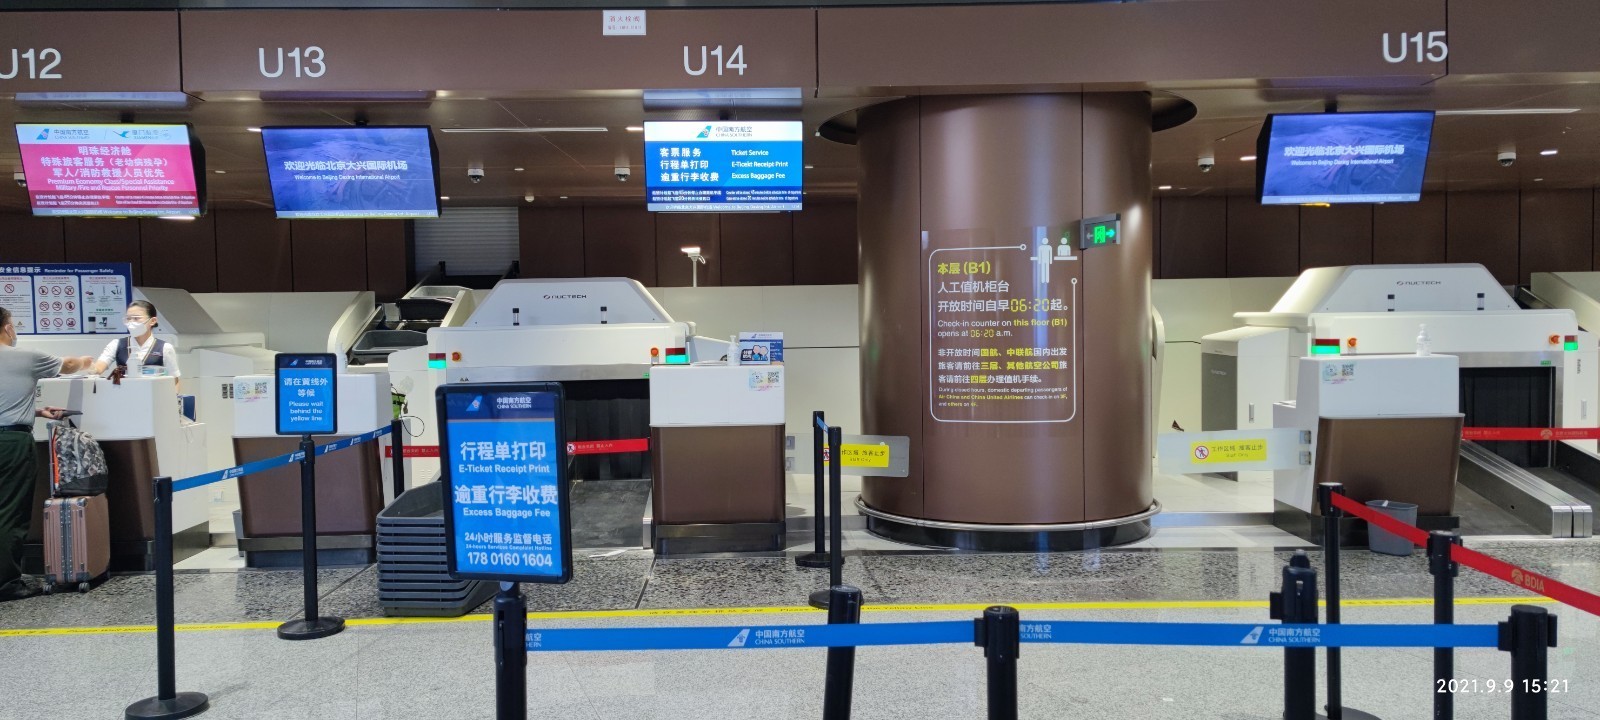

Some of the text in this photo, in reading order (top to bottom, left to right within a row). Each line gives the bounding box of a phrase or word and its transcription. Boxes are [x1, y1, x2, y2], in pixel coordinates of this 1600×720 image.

[1382, 31, 1448, 63] U15
[0, 48, 63, 79] U12
[258, 46, 327, 78] U13
[683, 45, 747, 76] U14
[77, 145, 132, 156] 明珠经济舱
[660, 147, 701, 157] 客票服务
[1284, 144, 1404, 156] 欢迎光临北京大兴国际机场
[284, 160, 408, 171] 欢迎光临北京大兴国际机场
[660, 159, 709, 170] 行程单打印
[753, 161, 774, 169] Receipt
[52, 167, 165, 178] 军人/消防救援人员优先
[660, 172, 719, 182] 逾重行李收费
[750, 172, 775, 180] Baggage
[75, 178, 103, 186] Economy
[937, 280, 1009, 293] 人工值机柜台
[937, 319, 970, 327] Check-in
[1013, 318, 1029, 326] this
[1031, 318, 1050, 326] floor
[1051, 318, 1067, 327] (B1)
[937, 330, 960, 338] opens
[970, 329, 994, 337] 06:20
[283, 377, 328, 386] 请在黄线外
[297, 388, 315, 397] 等候
[496, 396, 532, 404] 中国南方航空
[460, 441, 546, 461] 行程单打印
[458, 464, 550, 475] E-Ticket Receipt Print
[454, 485, 558, 505] 逾重行李收费
[463, 507, 551, 519] Excess Baggage Fee
[464, 532, 552, 545] 24小时服务监督电话
[467, 551, 553, 567] 178 0160 1604
[1524, 573, 1545, 592] BDIA
[755, 629, 805, 638] 中国南方航空
[1019, 624, 1052, 633] 南方航空
[1269, 627, 1320, 637] 中国南方航空
[774, 637, 805, 645] SOUTHERN
